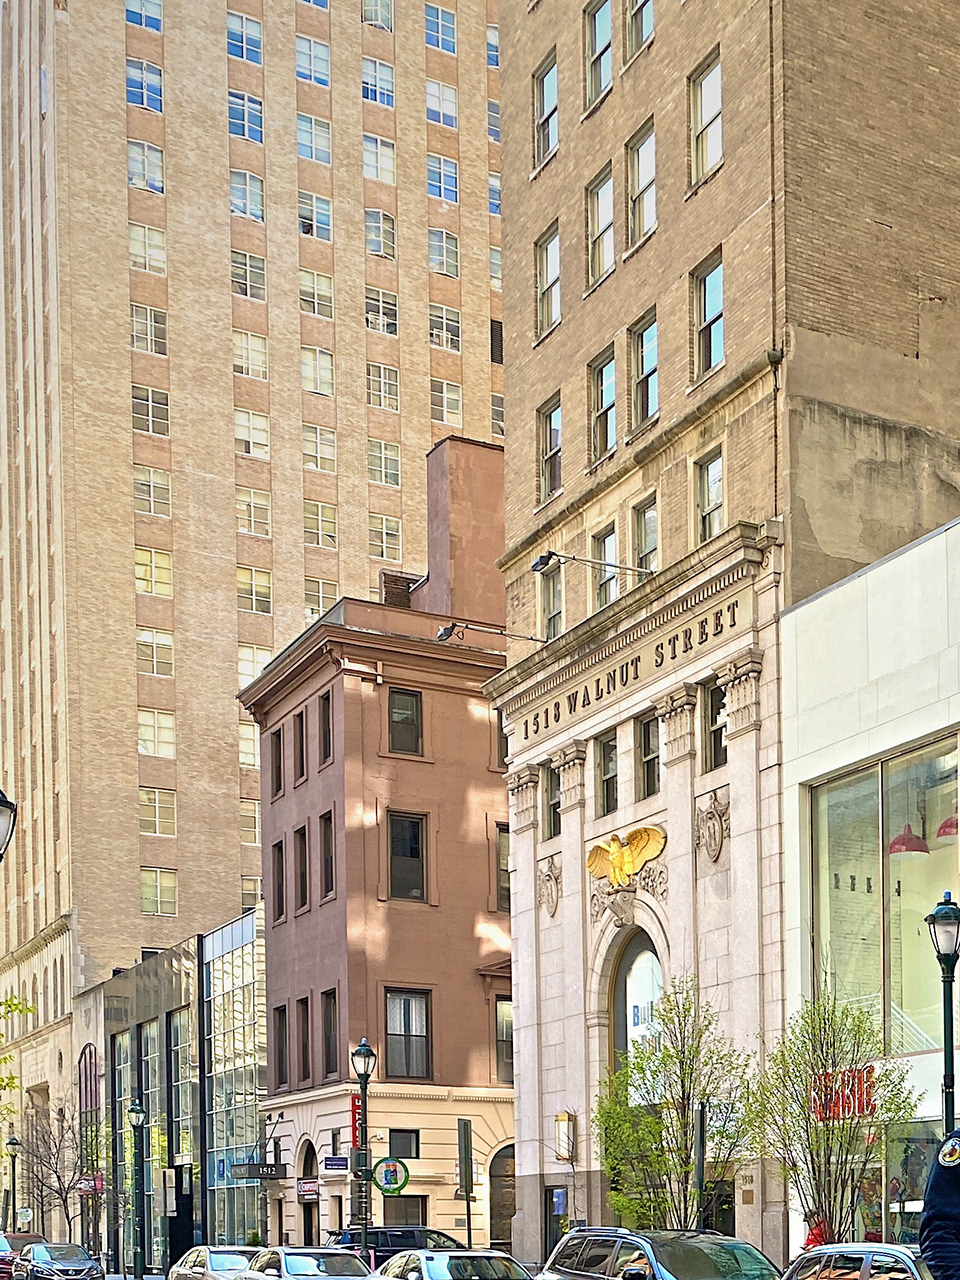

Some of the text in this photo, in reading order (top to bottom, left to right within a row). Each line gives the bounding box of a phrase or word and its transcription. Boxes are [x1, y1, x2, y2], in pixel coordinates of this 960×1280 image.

[523, 600, 739, 740] 1518 WALNUT STREET
[259, 1167, 276, 1175] 1512
